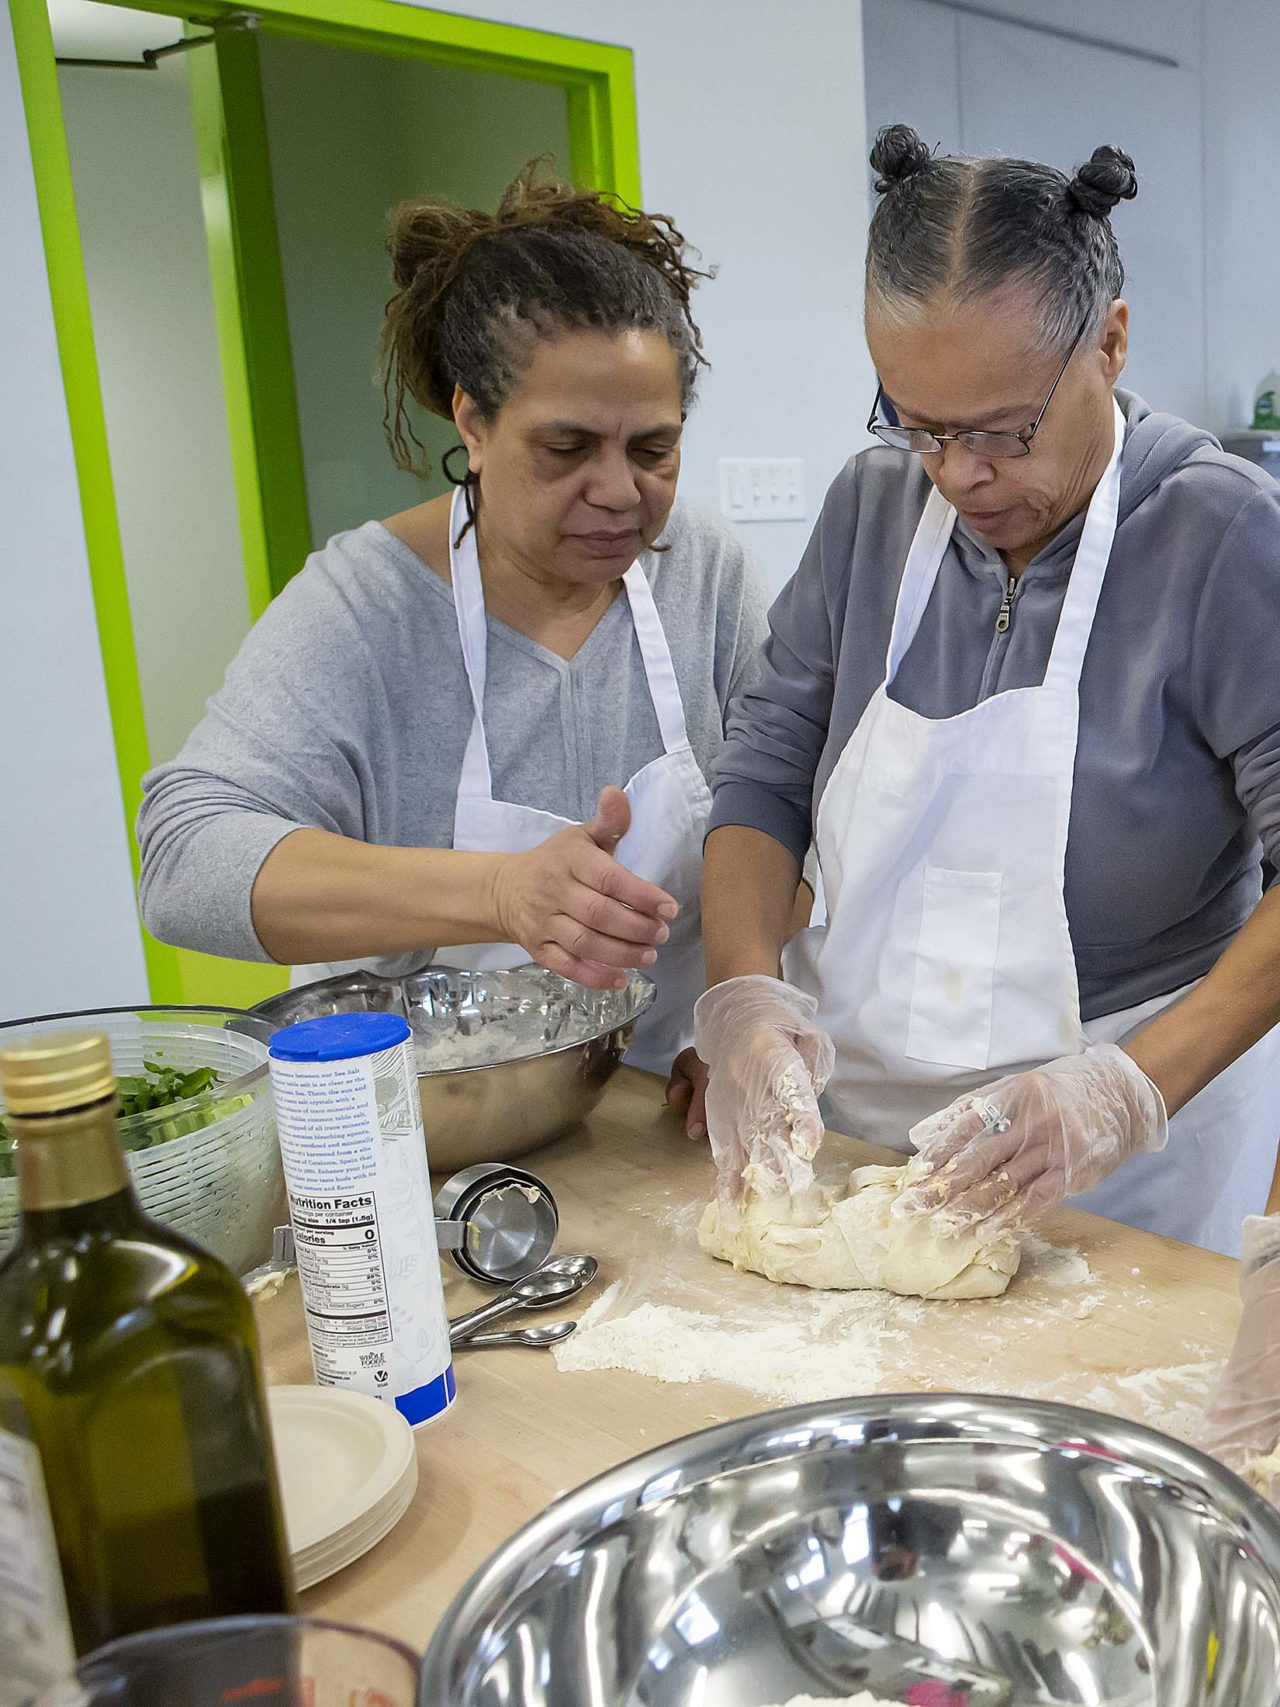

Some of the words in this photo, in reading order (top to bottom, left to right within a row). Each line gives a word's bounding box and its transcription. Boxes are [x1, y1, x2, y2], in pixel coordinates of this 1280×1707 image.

[334, 1196, 372, 1209] Facts
[364, 1229, 374, 1240] 0
[359, 1352, 384, 1361] WHOLE
